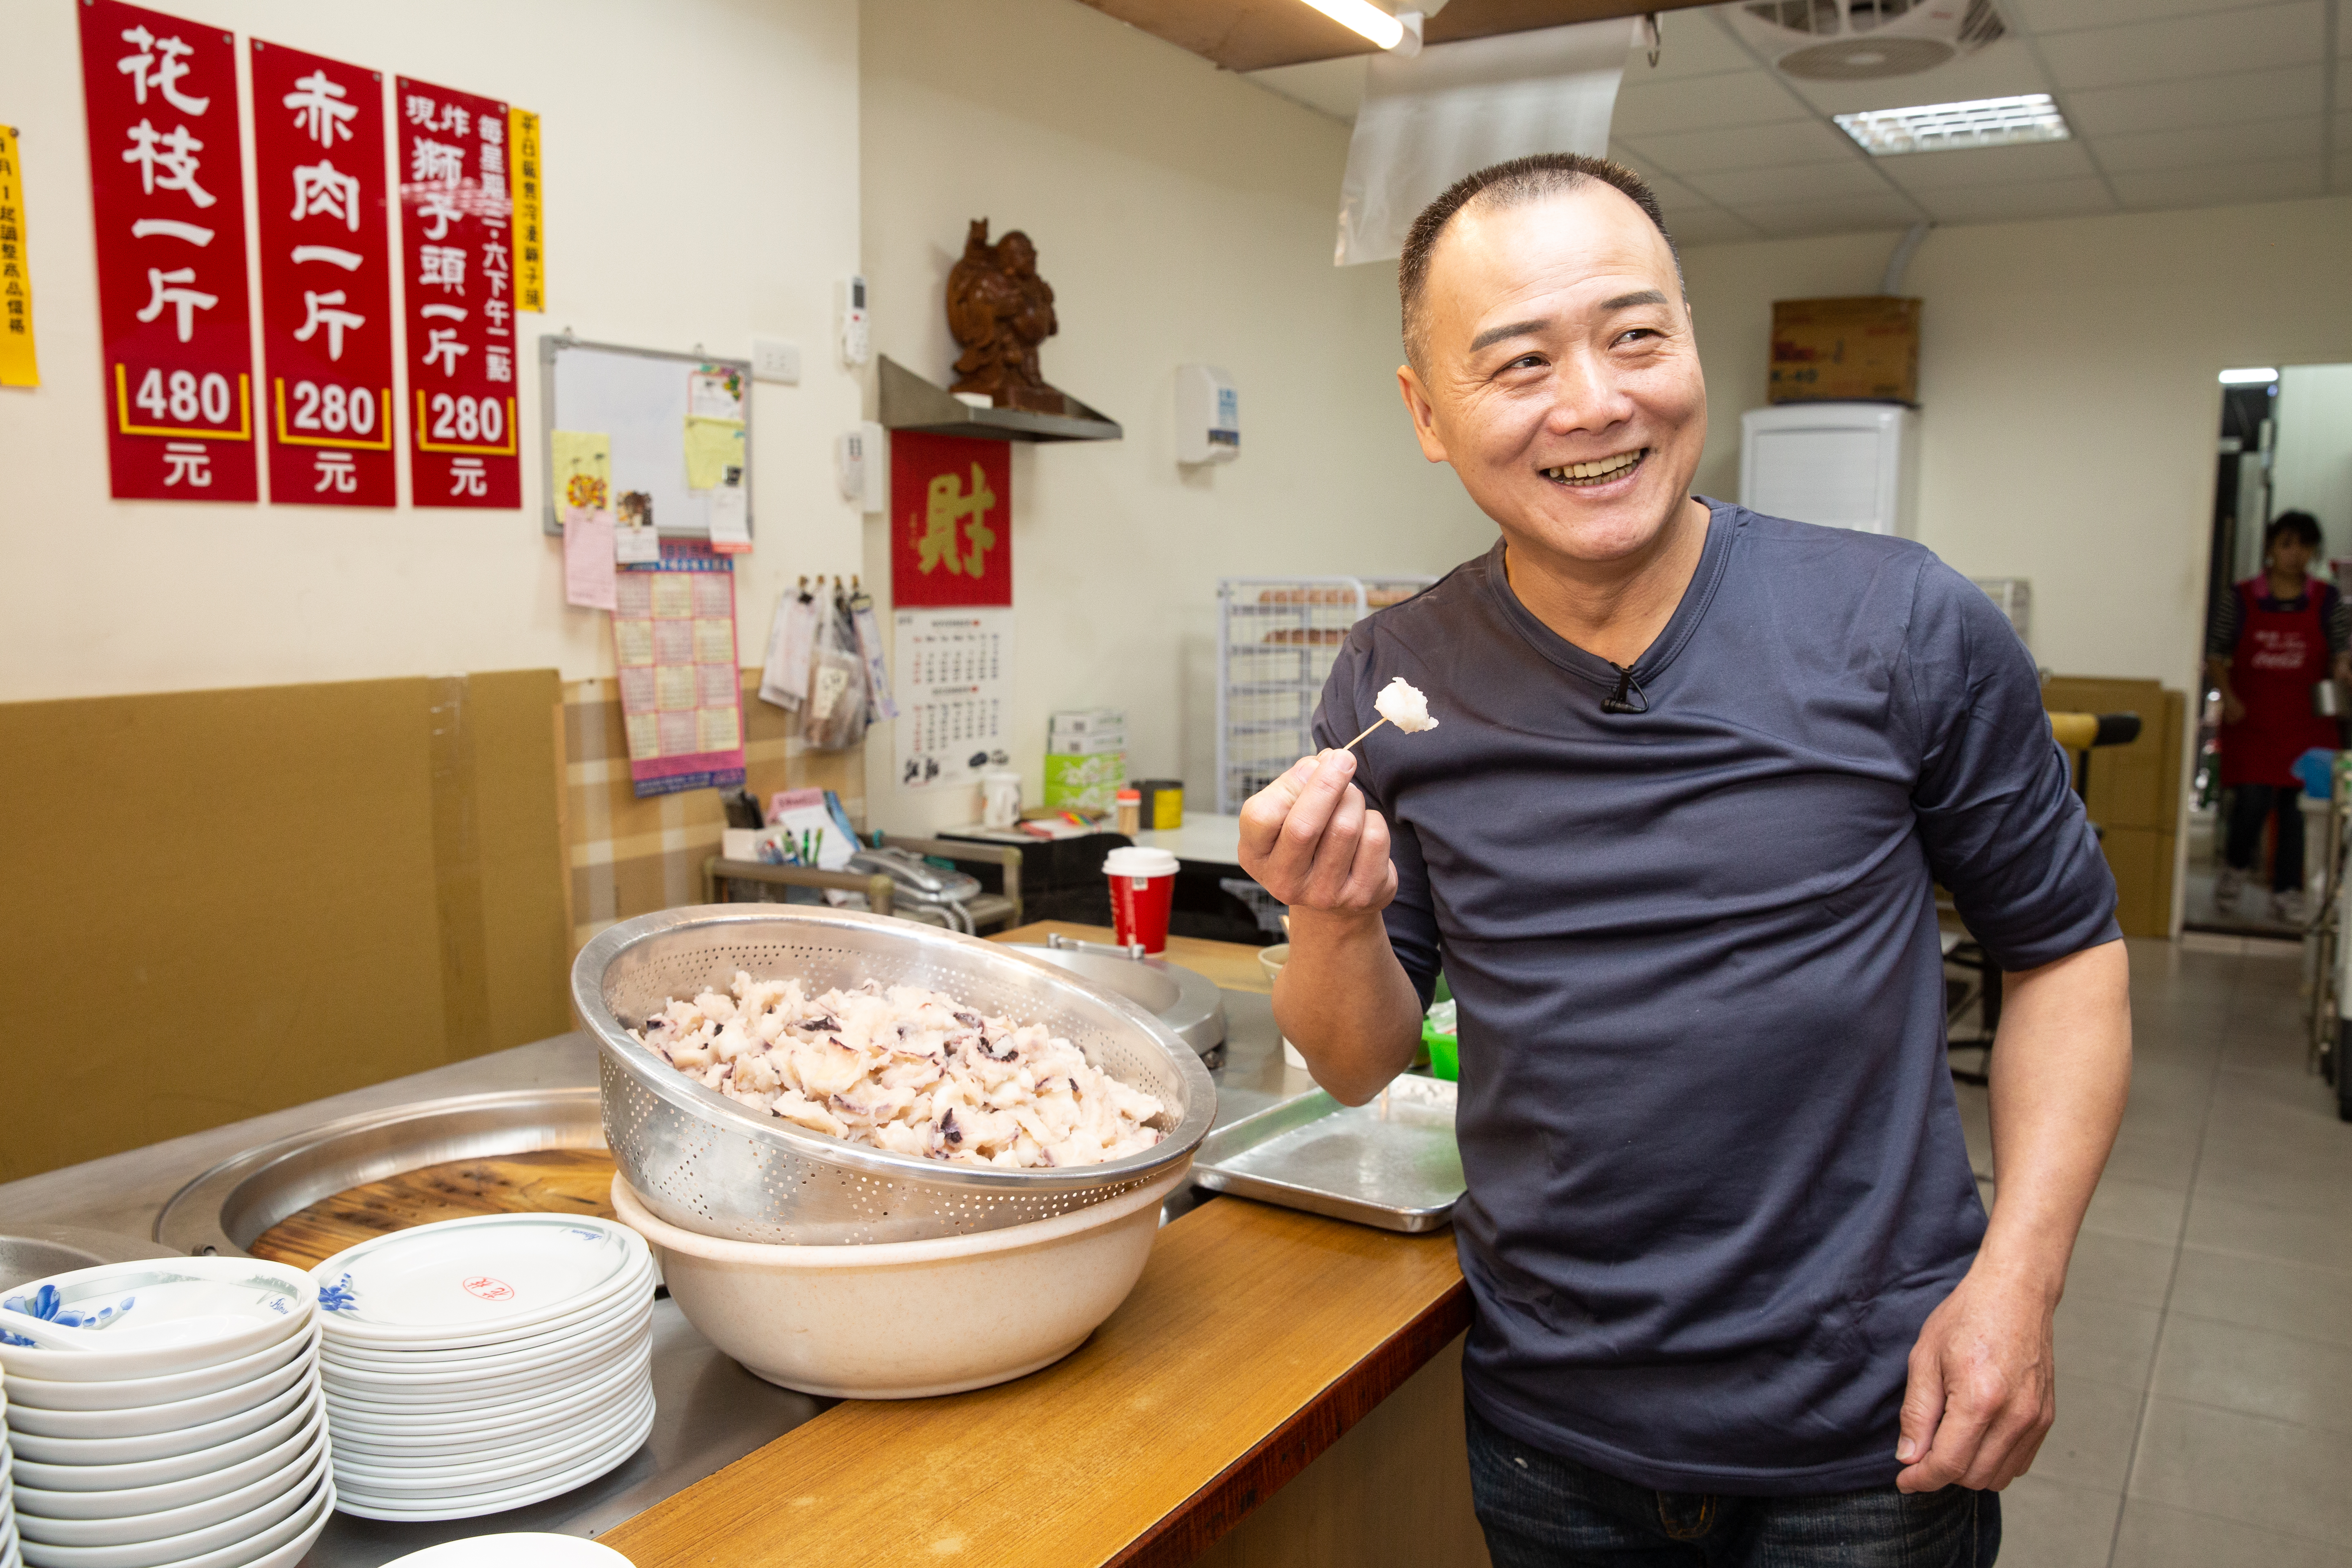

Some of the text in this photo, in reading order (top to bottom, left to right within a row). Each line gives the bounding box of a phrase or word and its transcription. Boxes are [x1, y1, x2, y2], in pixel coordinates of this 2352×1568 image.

[117, 24, 219, 343] 花枝一斤
[283, 69, 365, 361] 赤肉一斤
[136, 368, 230, 424] 480
[293, 381, 374, 435] 280
[432, 393, 503, 442] 280
[163, 442, 212, 487] 元
[314, 451, 357, 493] 元
[450, 457, 487, 497] 元
[918, 462, 996, 578] 財
